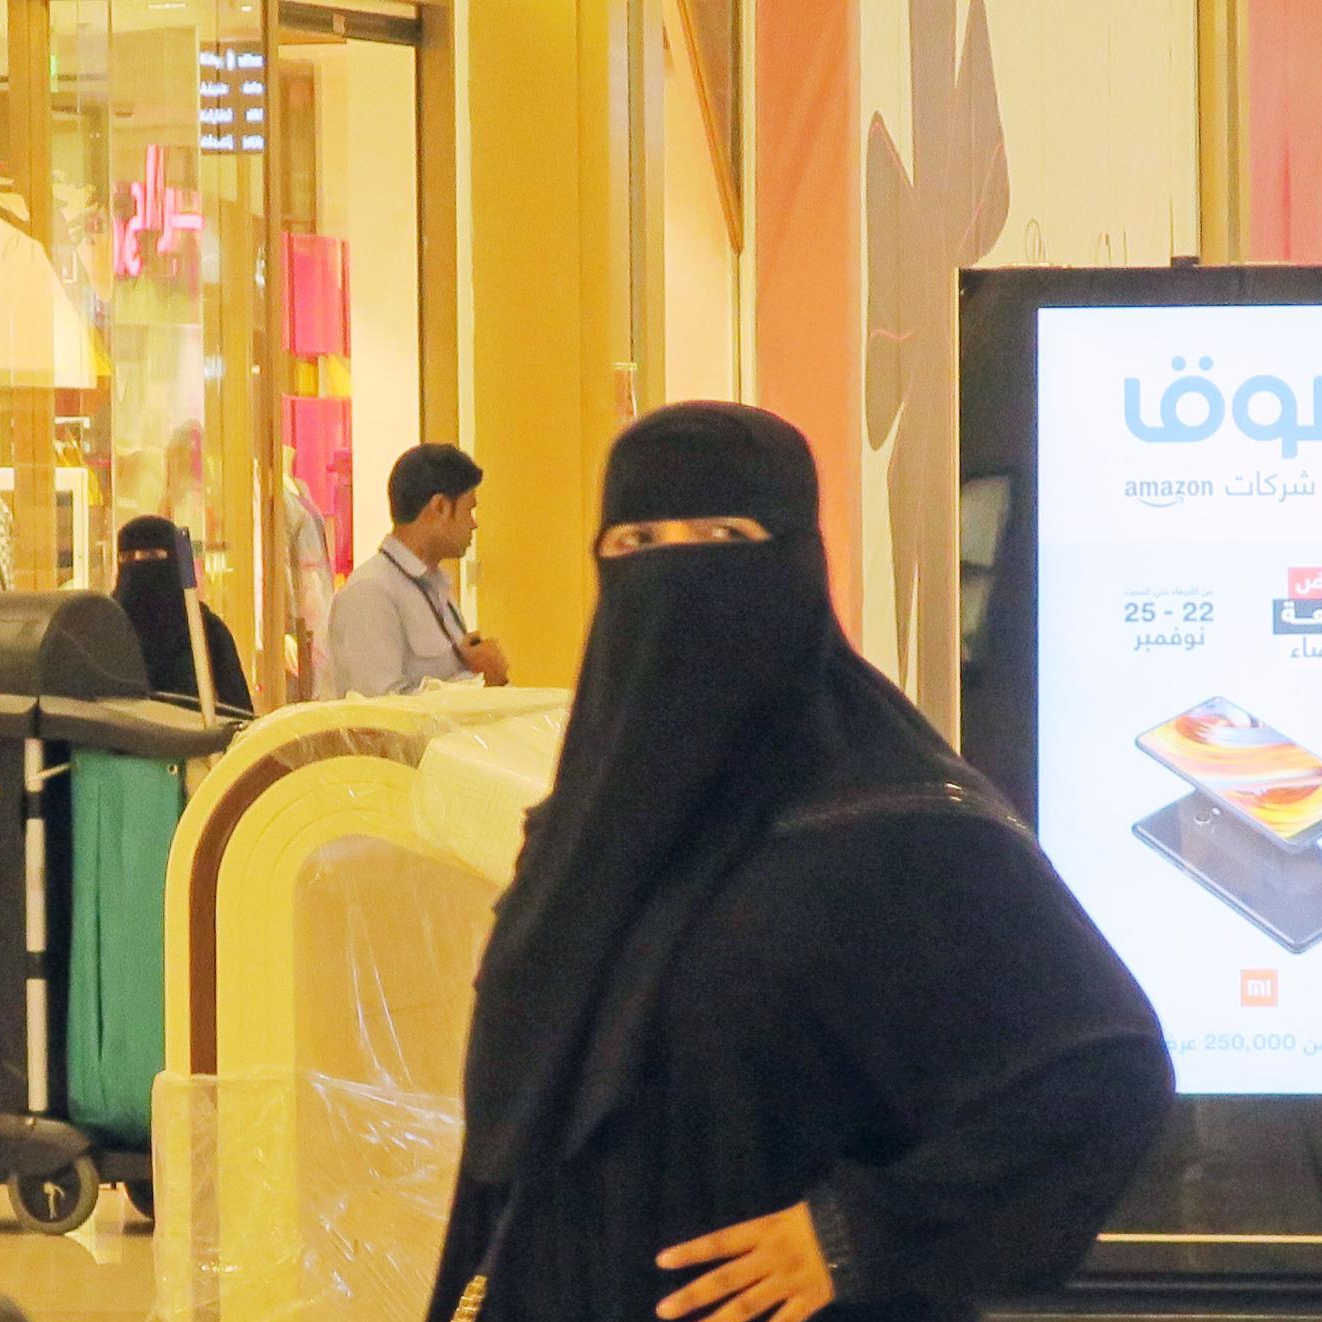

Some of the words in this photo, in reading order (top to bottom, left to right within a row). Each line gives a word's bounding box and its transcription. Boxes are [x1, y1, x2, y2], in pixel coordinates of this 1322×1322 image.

[1124, 479, 1214, 498] amazon
[1225, 470, 1316, 503] شركات
[1124, 601, 1156, 623] 25
[1182, 601, 1215, 623] 22
[1133, 626, 1205, 653] نوفمبر
[1204, 1033, 1297, 1054] 250,000
